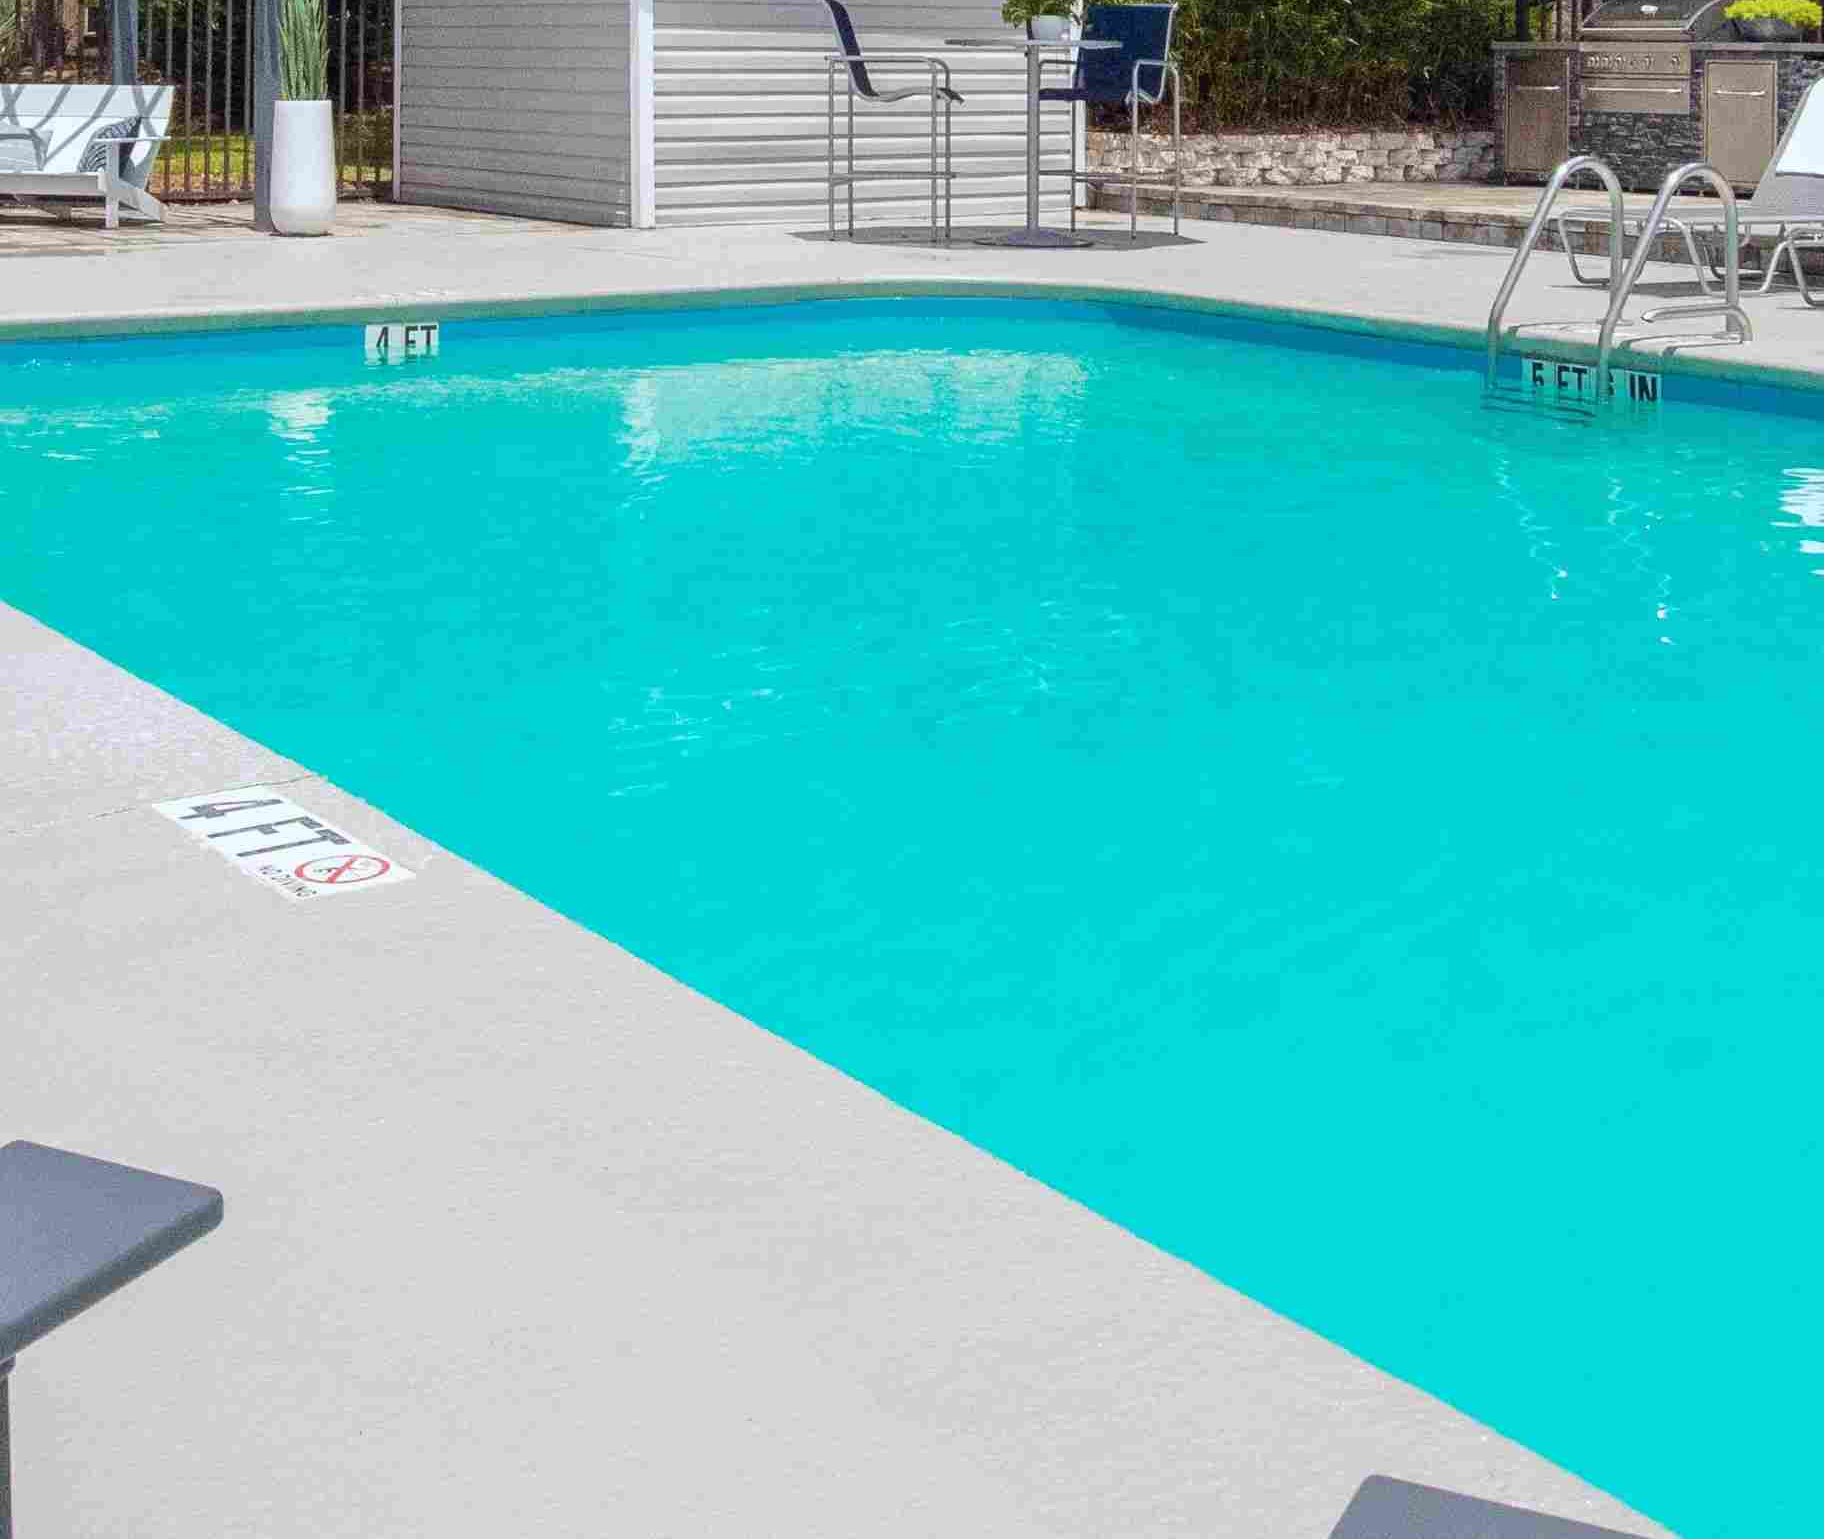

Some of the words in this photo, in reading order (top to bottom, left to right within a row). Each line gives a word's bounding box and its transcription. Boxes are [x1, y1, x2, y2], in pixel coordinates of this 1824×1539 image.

[1629, 374, 1657, 402] IN
[179, 798, 285, 820] 4
[207, 816, 351, 858] FT
